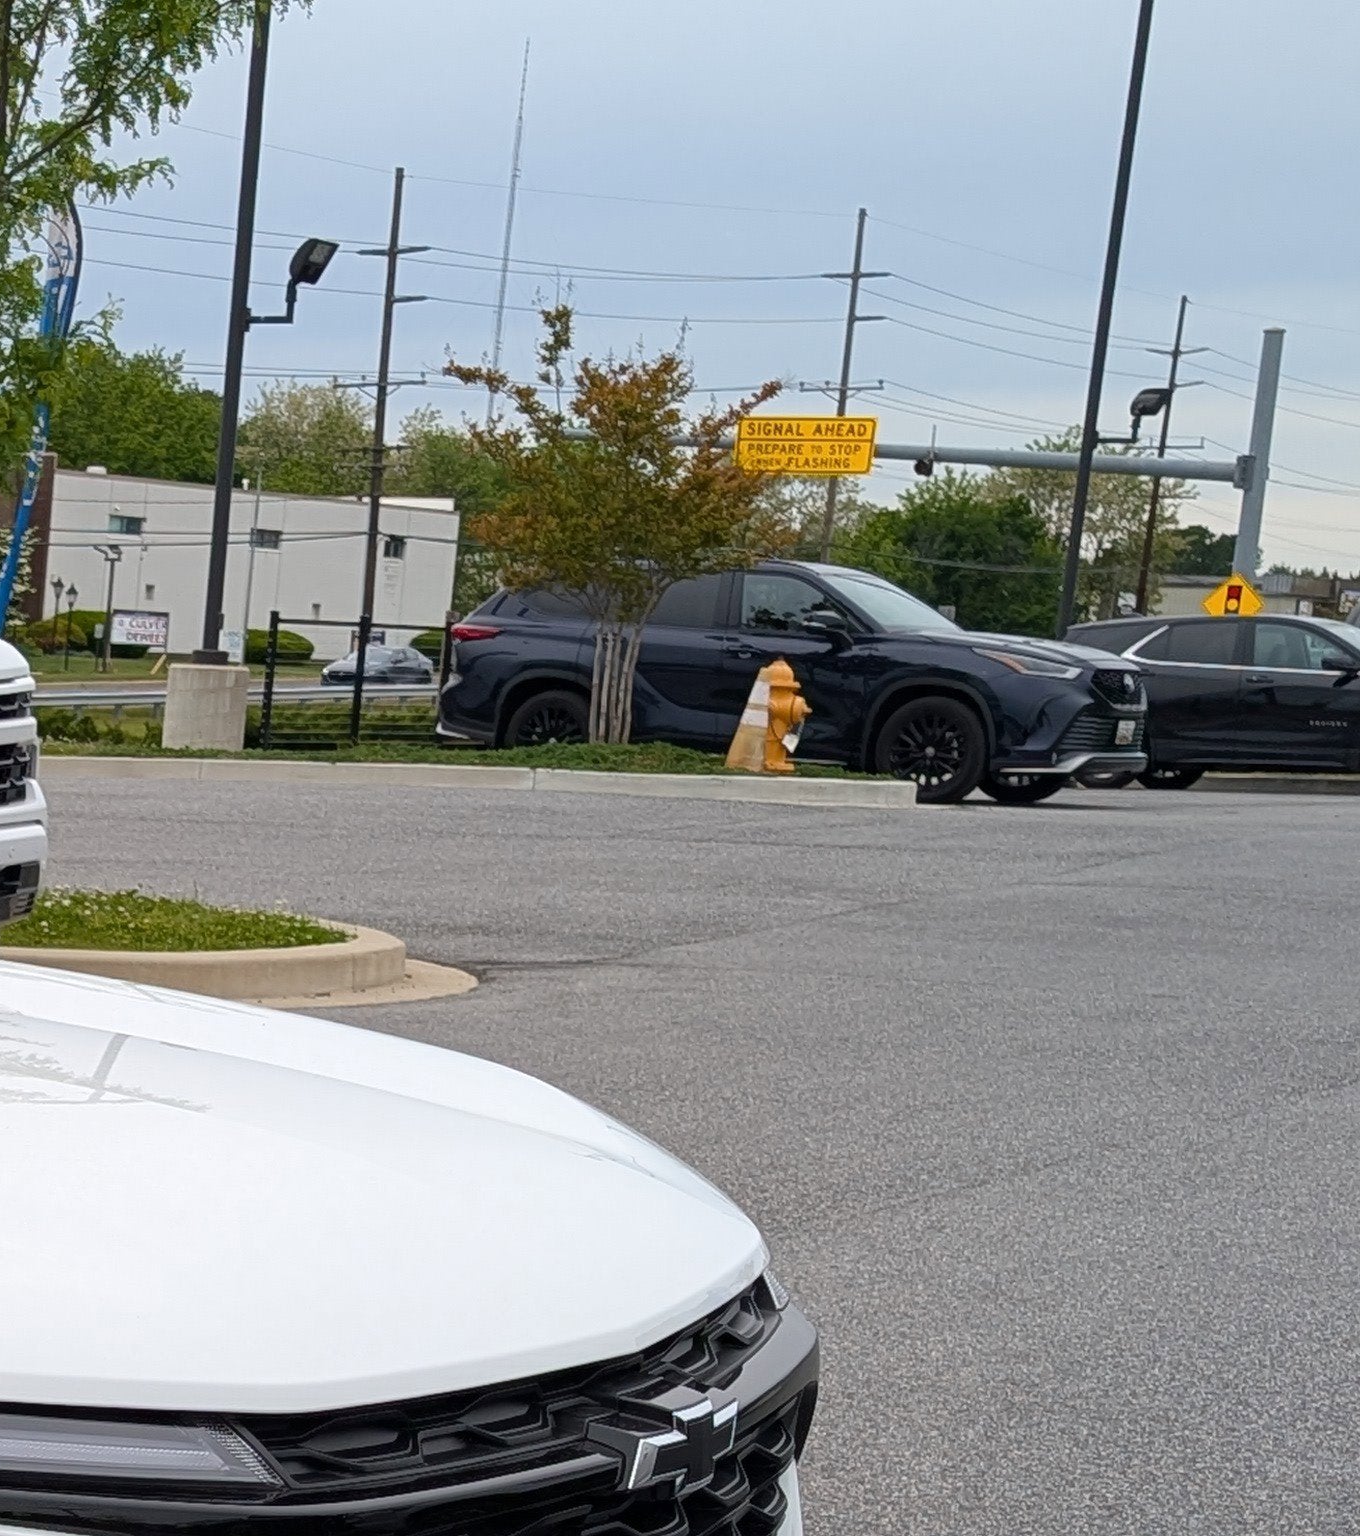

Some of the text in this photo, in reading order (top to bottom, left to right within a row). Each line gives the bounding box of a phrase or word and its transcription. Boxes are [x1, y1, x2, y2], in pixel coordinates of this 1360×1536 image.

[746, 421, 867, 437] SIGNAL AHEAD
[747, 443, 862, 456] PREPARE TO STOP
[786, 456, 851, 469] FLASHING
